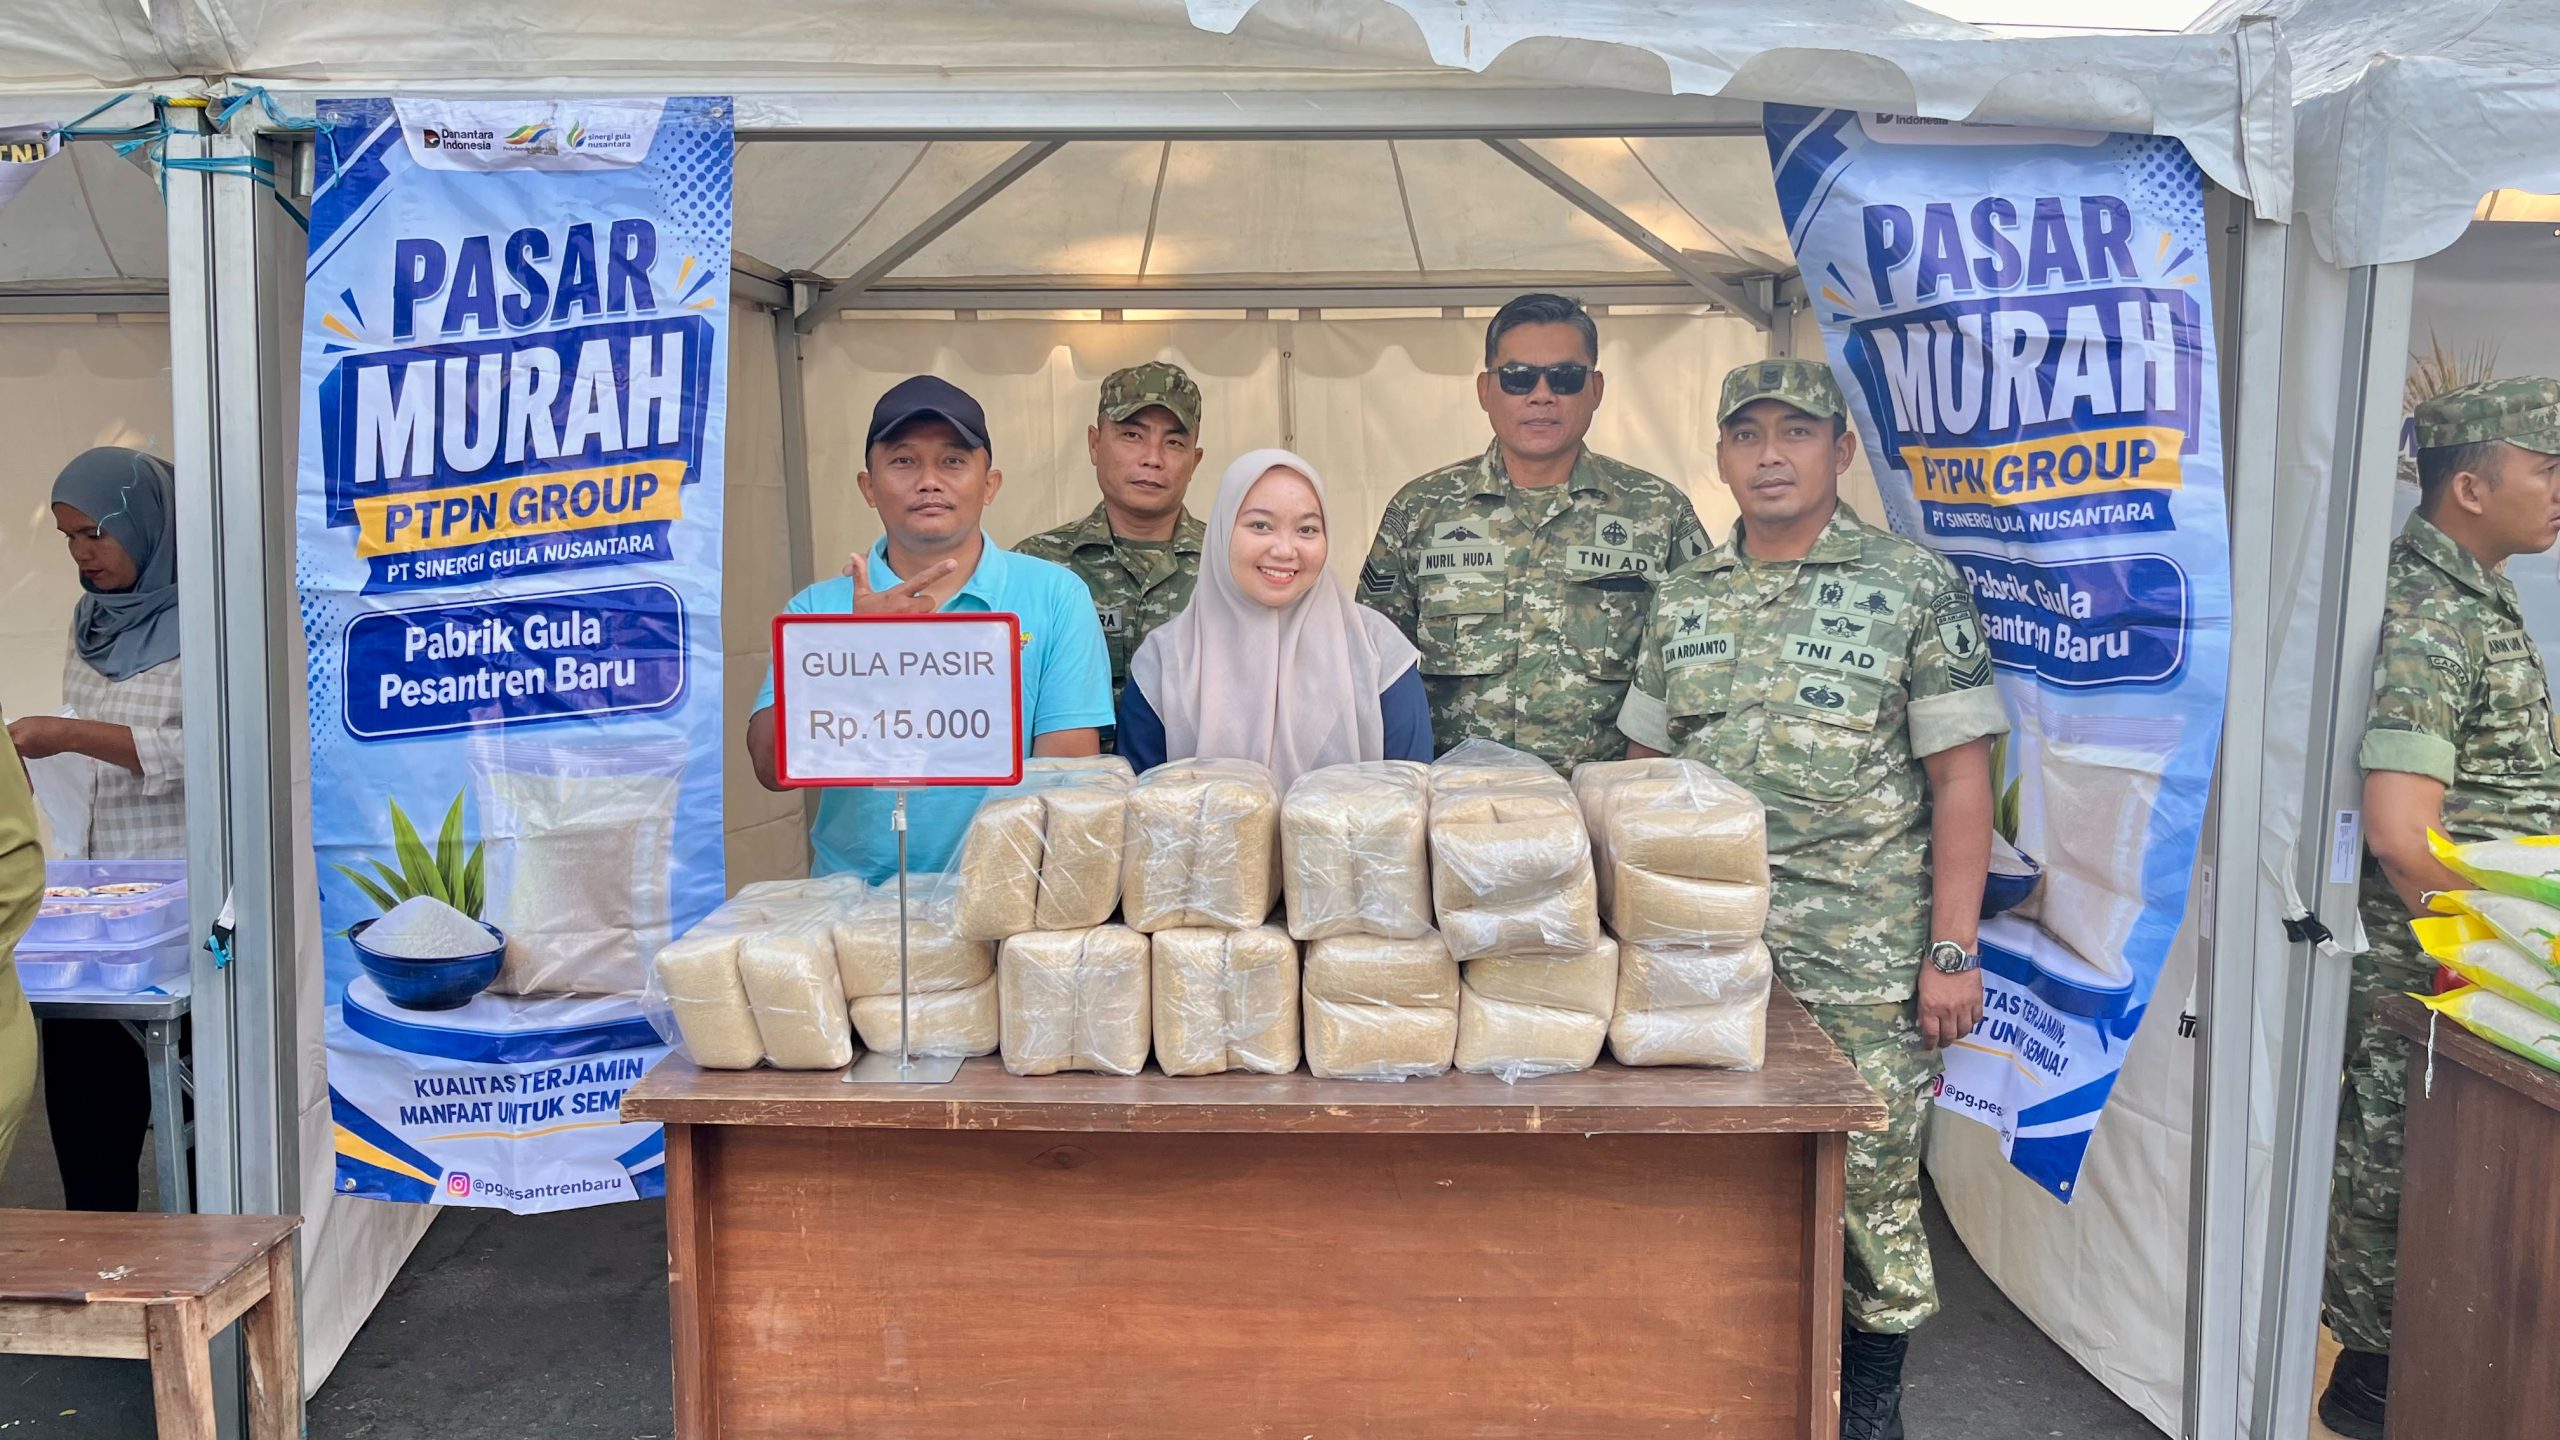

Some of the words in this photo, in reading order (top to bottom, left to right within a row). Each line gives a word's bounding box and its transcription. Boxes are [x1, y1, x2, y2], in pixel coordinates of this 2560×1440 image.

[441, 128, 494, 140] Danantara
[443, 139, 492, 150] Indonesia
[587, 132, 614, 143] sinergi
[614, 132, 632, 143] gula
[1862, 195, 2141, 309] PASAR
[392, 218, 658, 339] PASAR
[1870, 301, 2176, 435] MURAH
[354, 332, 685, 484] MURAH
[1922, 455, 1988, 495] PTPN
[1992, 438, 2157, 496] GROUP
[384, 491, 500, 544] PTPN
[508, 472, 660, 525] GROUP
[1932, 510, 1947, 529] PT
[1948, 511, 1993, 531] SINERGI
[2029, 502, 2155, 532] NUSANTARA
[386, 561, 410, 584] PT
[414, 551, 486, 580] SINERGI
[489, 546, 539, 570] GULA
[543, 533, 655, 564] NUSANTARA
[1425, 553, 1457, 570] NURIL
[1462, 551, 1493, 567] HUDA
[1578, 551, 1610, 568] TNI
[1619, 556, 1648, 573] AD
[1962, 565, 2037, 608] Pabrik
[2034, 578, 2092, 620] Gula
[404, 618, 515, 663] Pabrik
[522, 610, 602, 652] Gula
[1677, 639, 1728, 660] ARDIANTO
[1796, 641, 1832, 661] TNI
[1839, 649, 1875, 669] AD
[2054, 622, 2130, 663] Baru
[379, 664, 548, 711] Pesantren
[554, 656, 636, 694] Baru
[801, 651, 890, 677] GULA
[899, 650, 996, 677] PASIR
[808, 708, 991, 746] Rp.15.000
[2021, 998, 2066, 1049] TERJAMIN,
[413, 1074, 518, 1099] KUALITAS
[519, 1056, 648, 1095] TERJAMIN
[2022, 1036, 2069, 1078] SEMUA!
[399, 1100, 494, 1127] MANFAAT
[497, 1095, 566, 1125] UNTUK
[571, 1088, 627, 1115] SEM
